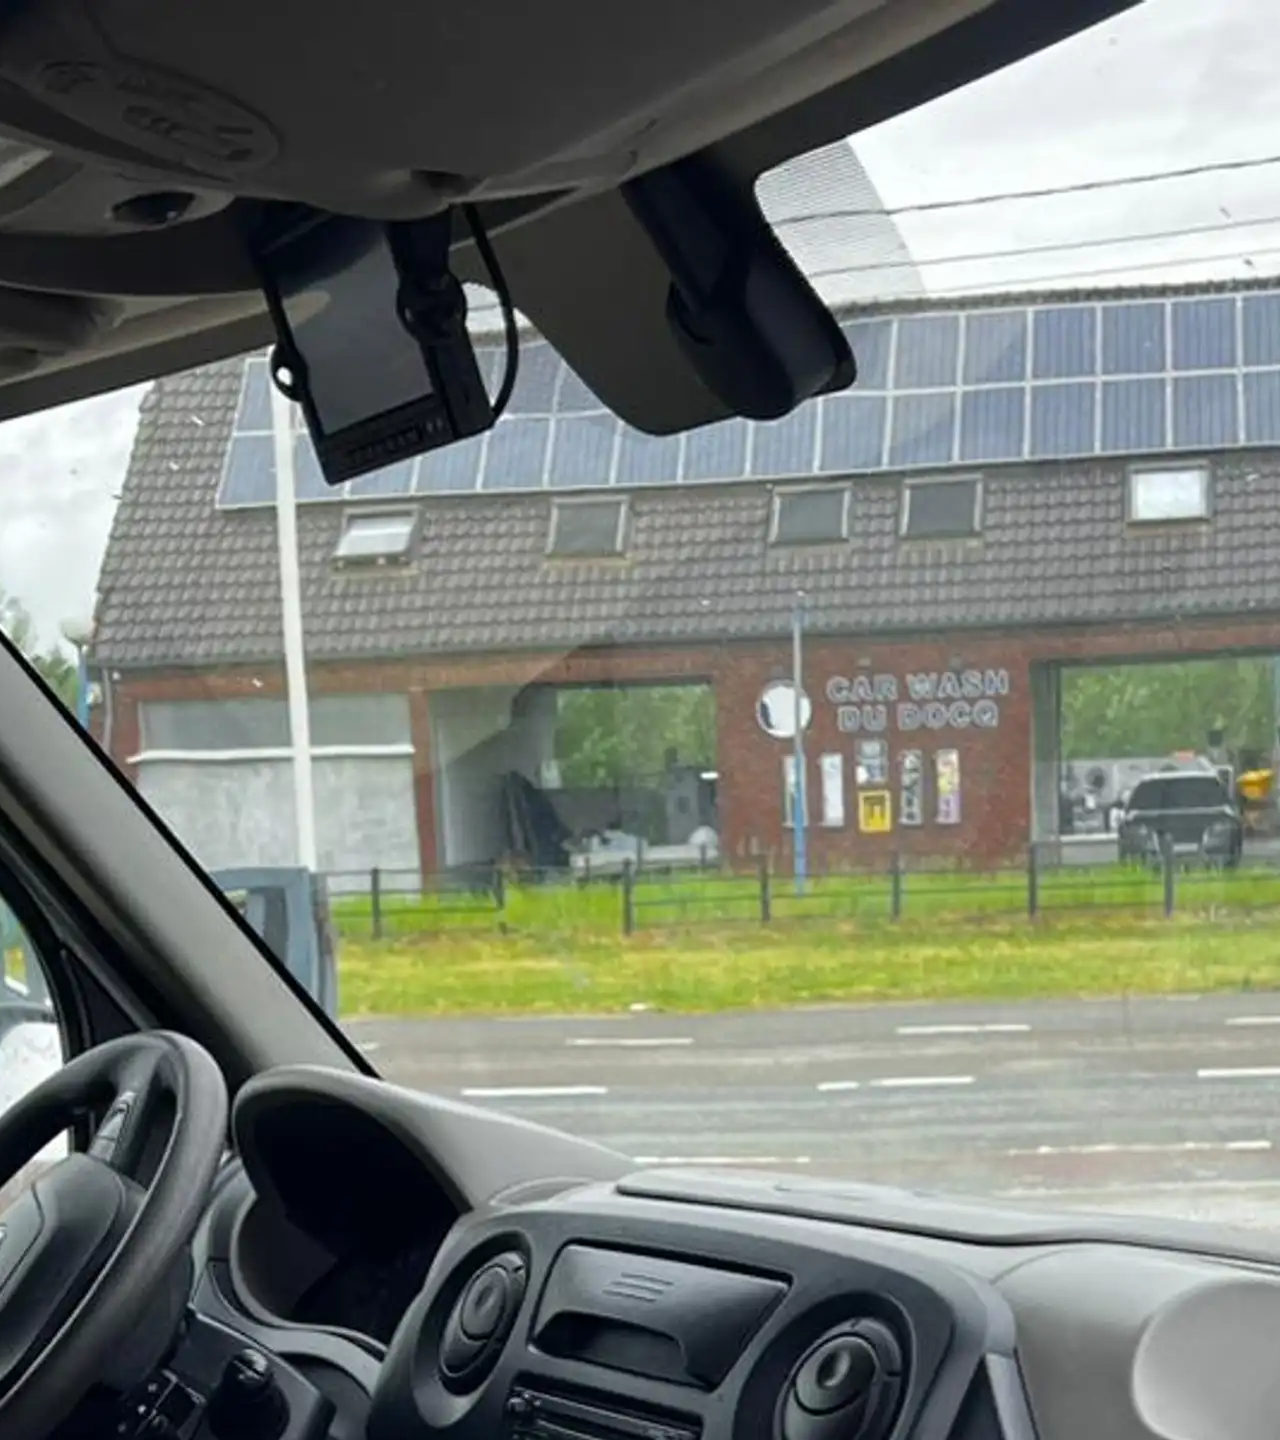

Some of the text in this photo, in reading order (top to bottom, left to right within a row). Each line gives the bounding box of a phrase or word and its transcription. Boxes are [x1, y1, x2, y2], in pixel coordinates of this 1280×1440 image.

[825, 667, 1010, 704] CAR WASH
[836, 703, 888, 733] DU
